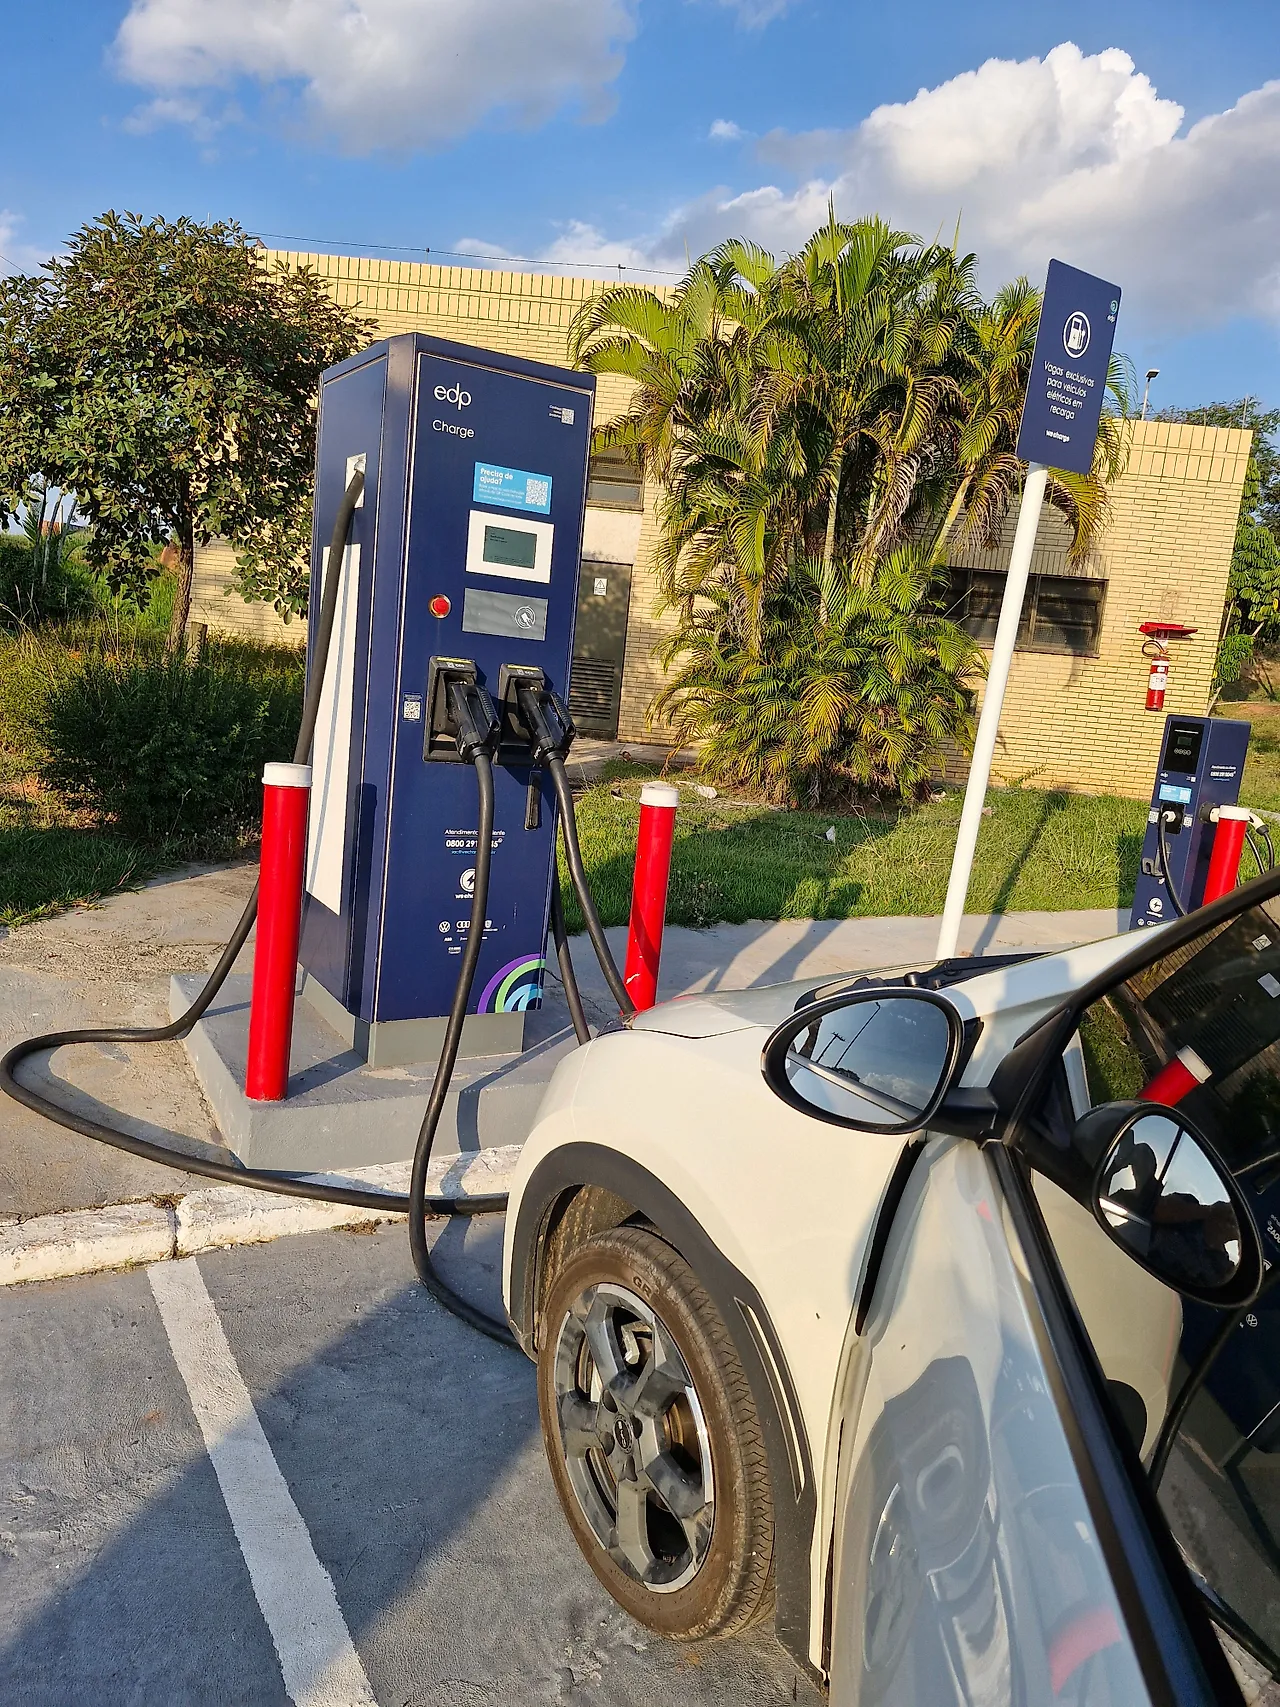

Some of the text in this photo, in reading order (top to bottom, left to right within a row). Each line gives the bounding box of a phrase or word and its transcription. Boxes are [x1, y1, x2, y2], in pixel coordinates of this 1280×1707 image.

[1044, 360, 1095, 388] Vagas exclusivas
[1046, 377, 1087, 398] para veículos
[433, 382, 472, 411] edp
[1072, 399, 1083, 409] em
[1049, 404, 1075, 420] recarga
[432, 419, 475, 439] Charge
[479, 476, 503, 486] ajuda?
[480, 467, 514, 480] Precisa de
[445, 839, 465, 848] 0800
[465, 840, 478, 848] 291
